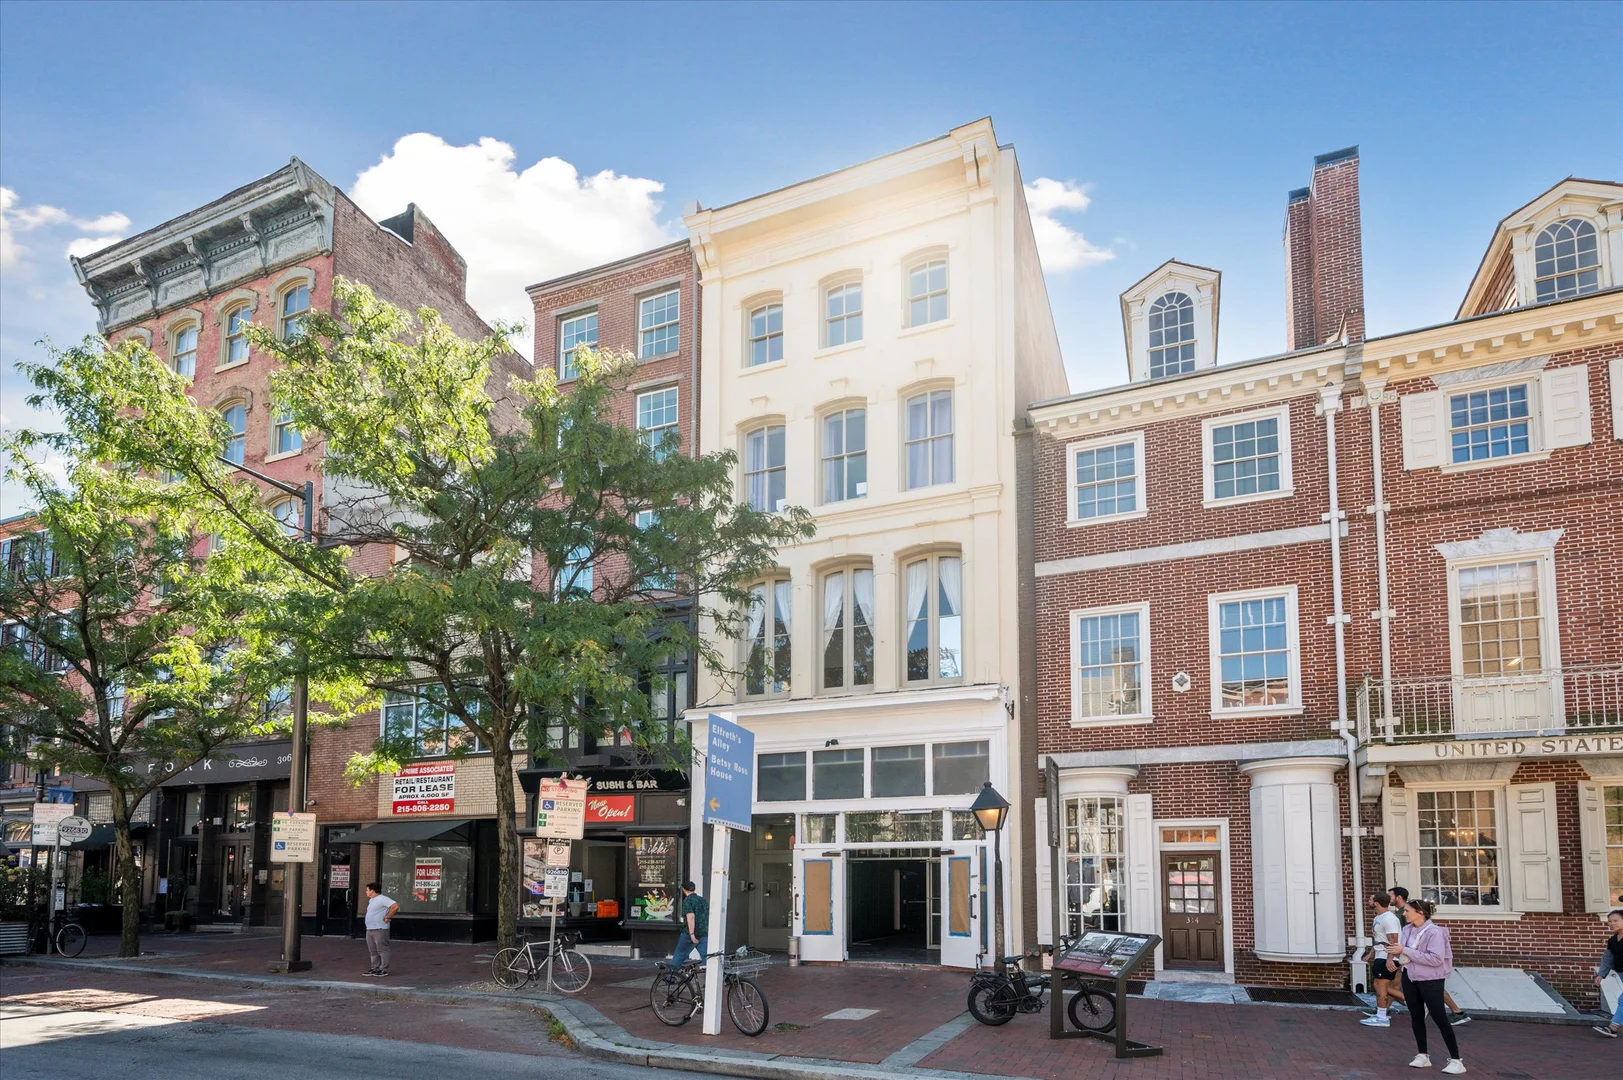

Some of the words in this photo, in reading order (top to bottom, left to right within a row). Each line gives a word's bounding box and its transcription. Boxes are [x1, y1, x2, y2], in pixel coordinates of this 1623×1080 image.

[712, 724, 742, 744] Elfreth's
[712, 737, 731, 752] Alley
[1434, 741, 1526, 758] UNITED
[277, 753, 292, 765] 306
[711, 754, 732, 770] Betsy
[733, 761, 748, 776] Ross
[420, 765, 454, 774] ASSOCIATES
[710, 766, 733, 781] House
[395, 775, 454, 786] RETAIL/RESTAURANT
[596, 780, 625, 790] SUSHI
[626, 780, 635, 789] &
[636, 780, 658, 789] BAR
[394, 785, 416, 794] FOR
[419, 783, 454, 793] LEASE
[588, 799, 608, 810] Now
[598, 804, 632, 819] Open!
[416, 868, 426, 877] FOR
[426, 868, 441, 877] LEASE
